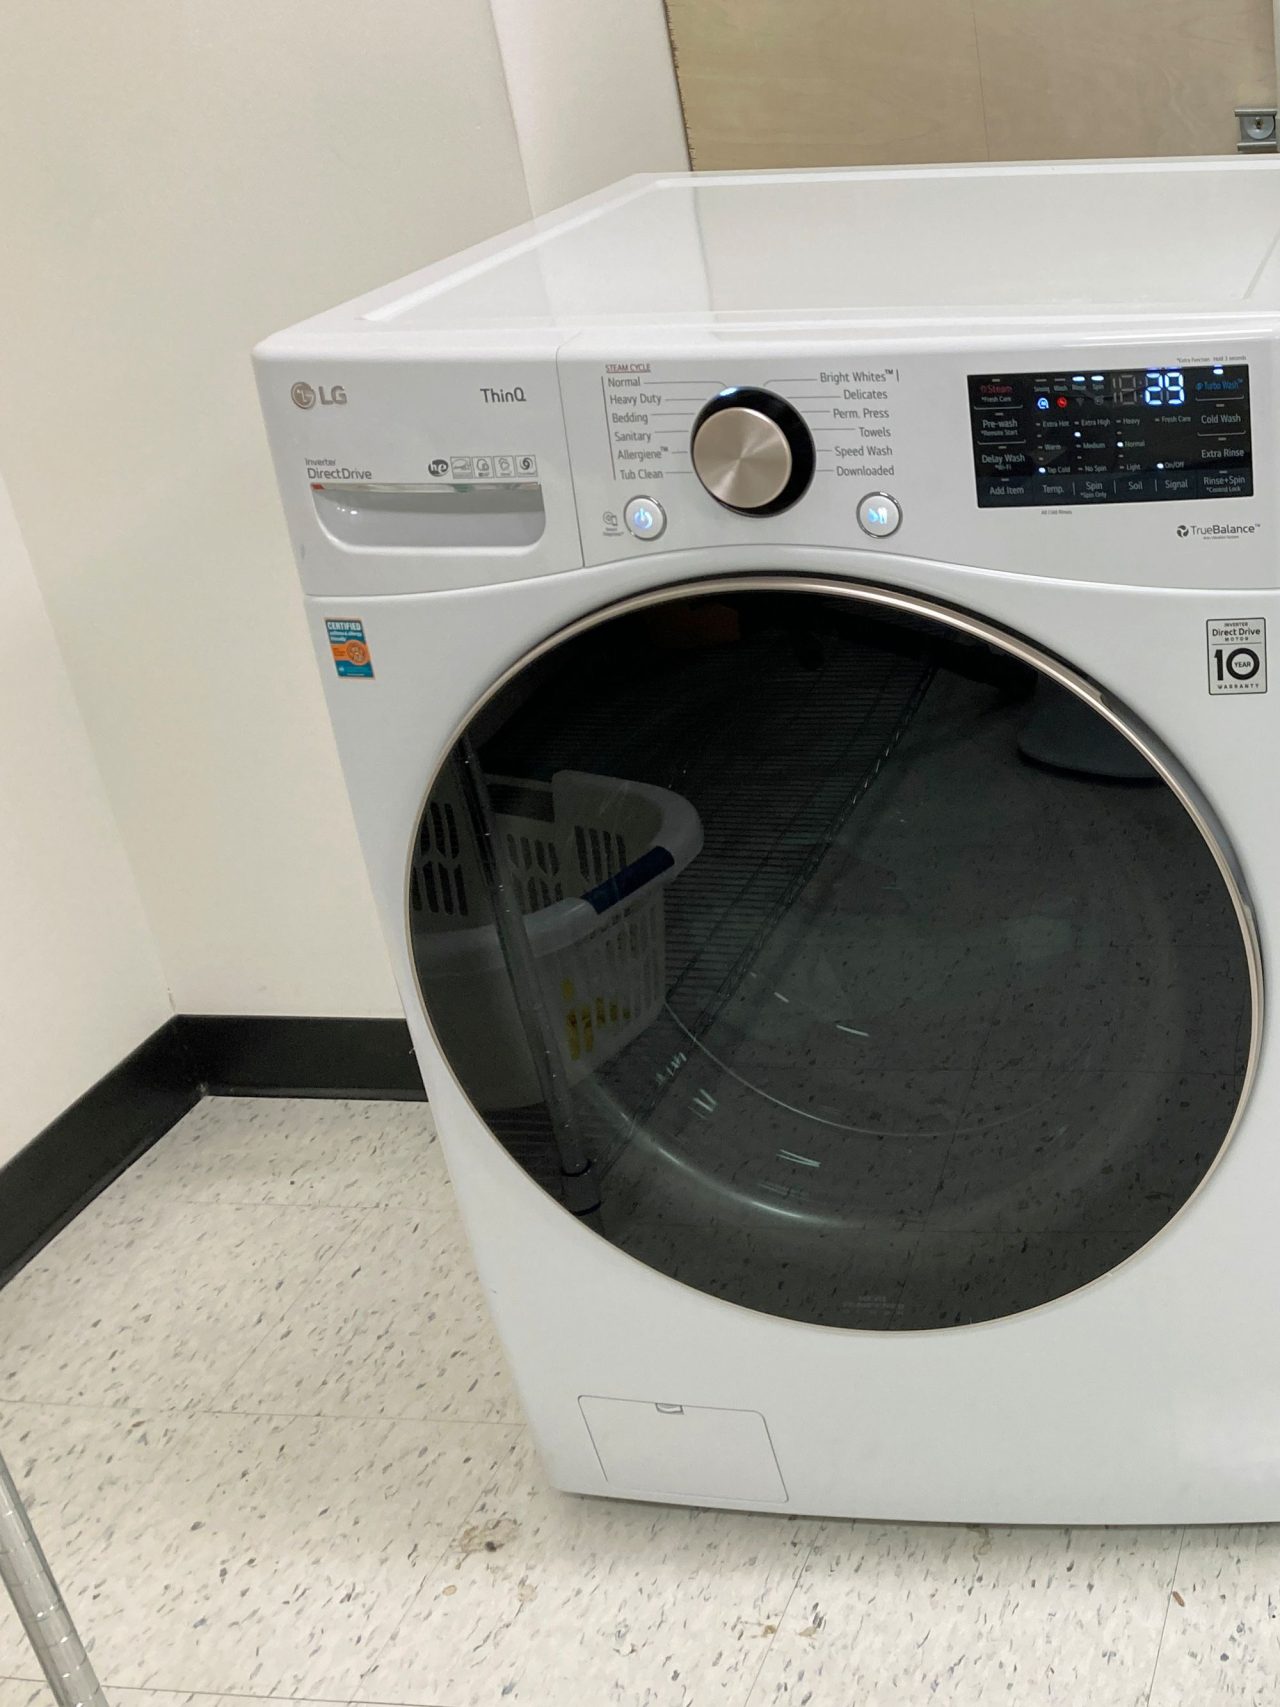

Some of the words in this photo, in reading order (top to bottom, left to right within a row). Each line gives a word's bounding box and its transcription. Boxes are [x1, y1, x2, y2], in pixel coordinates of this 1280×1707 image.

[605, 363, 628, 374] STEAM
[629, 362, 651, 373] CYCLE
[607, 376, 641, 388] Normal
[820, 371, 850, 385] Bright
[1144, 371, 1186, 406] 29
[319, 385, 347, 405] LG
[480, 387, 527, 404] ThinQ
[610, 394, 637, 406] Heavy
[639, 393, 662, 406] Duty
[843, 389, 888, 400] Delicates
[612, 412, 648, 425] Bedding
[833, 408, 860, 419] Perm.
[863, 407, 890, 418] Press
[982, 418, 1018, 429] Pre-wash
[1201, 415, 1218, 424] Cold
[1220, 414, 1241, 424] Wash
[614, 432, 651, 443] Sanitary
[858, 426, 891, 438] Towels
[834, 445, 864, 459] Speed
[866, 445, 893, 456] Wash
[1201, 449, 1221, 459] Extra
[1223, 448, 1245, 457] Rinse
[304, 457, 336, 467] Inverter
[981, 454, 1003, 464] Delay
[1004, 453, 1026, 463] Wash
[620, 469, 636, 480] Tub
[638, 468, 664, 480] Clean
[836, 464, 895, 477] Downloaded
[989, 486, 1005, 495] Add
[1006, 486, 1024, 495] Item
[1042, 484, 1064, 495] Temp.
[1085, 481, 1103, 492] Spin
[1128, 481, 1143, 490] Soil
[1164, 480, 1188, 491] Signal
[327, 621, 362, 631] CERTIFIED
[1212, 628, 1237, 637] Direct
[1238, 627, 1261, 636] Drive
[1214, 647, 1260, 681] 10
